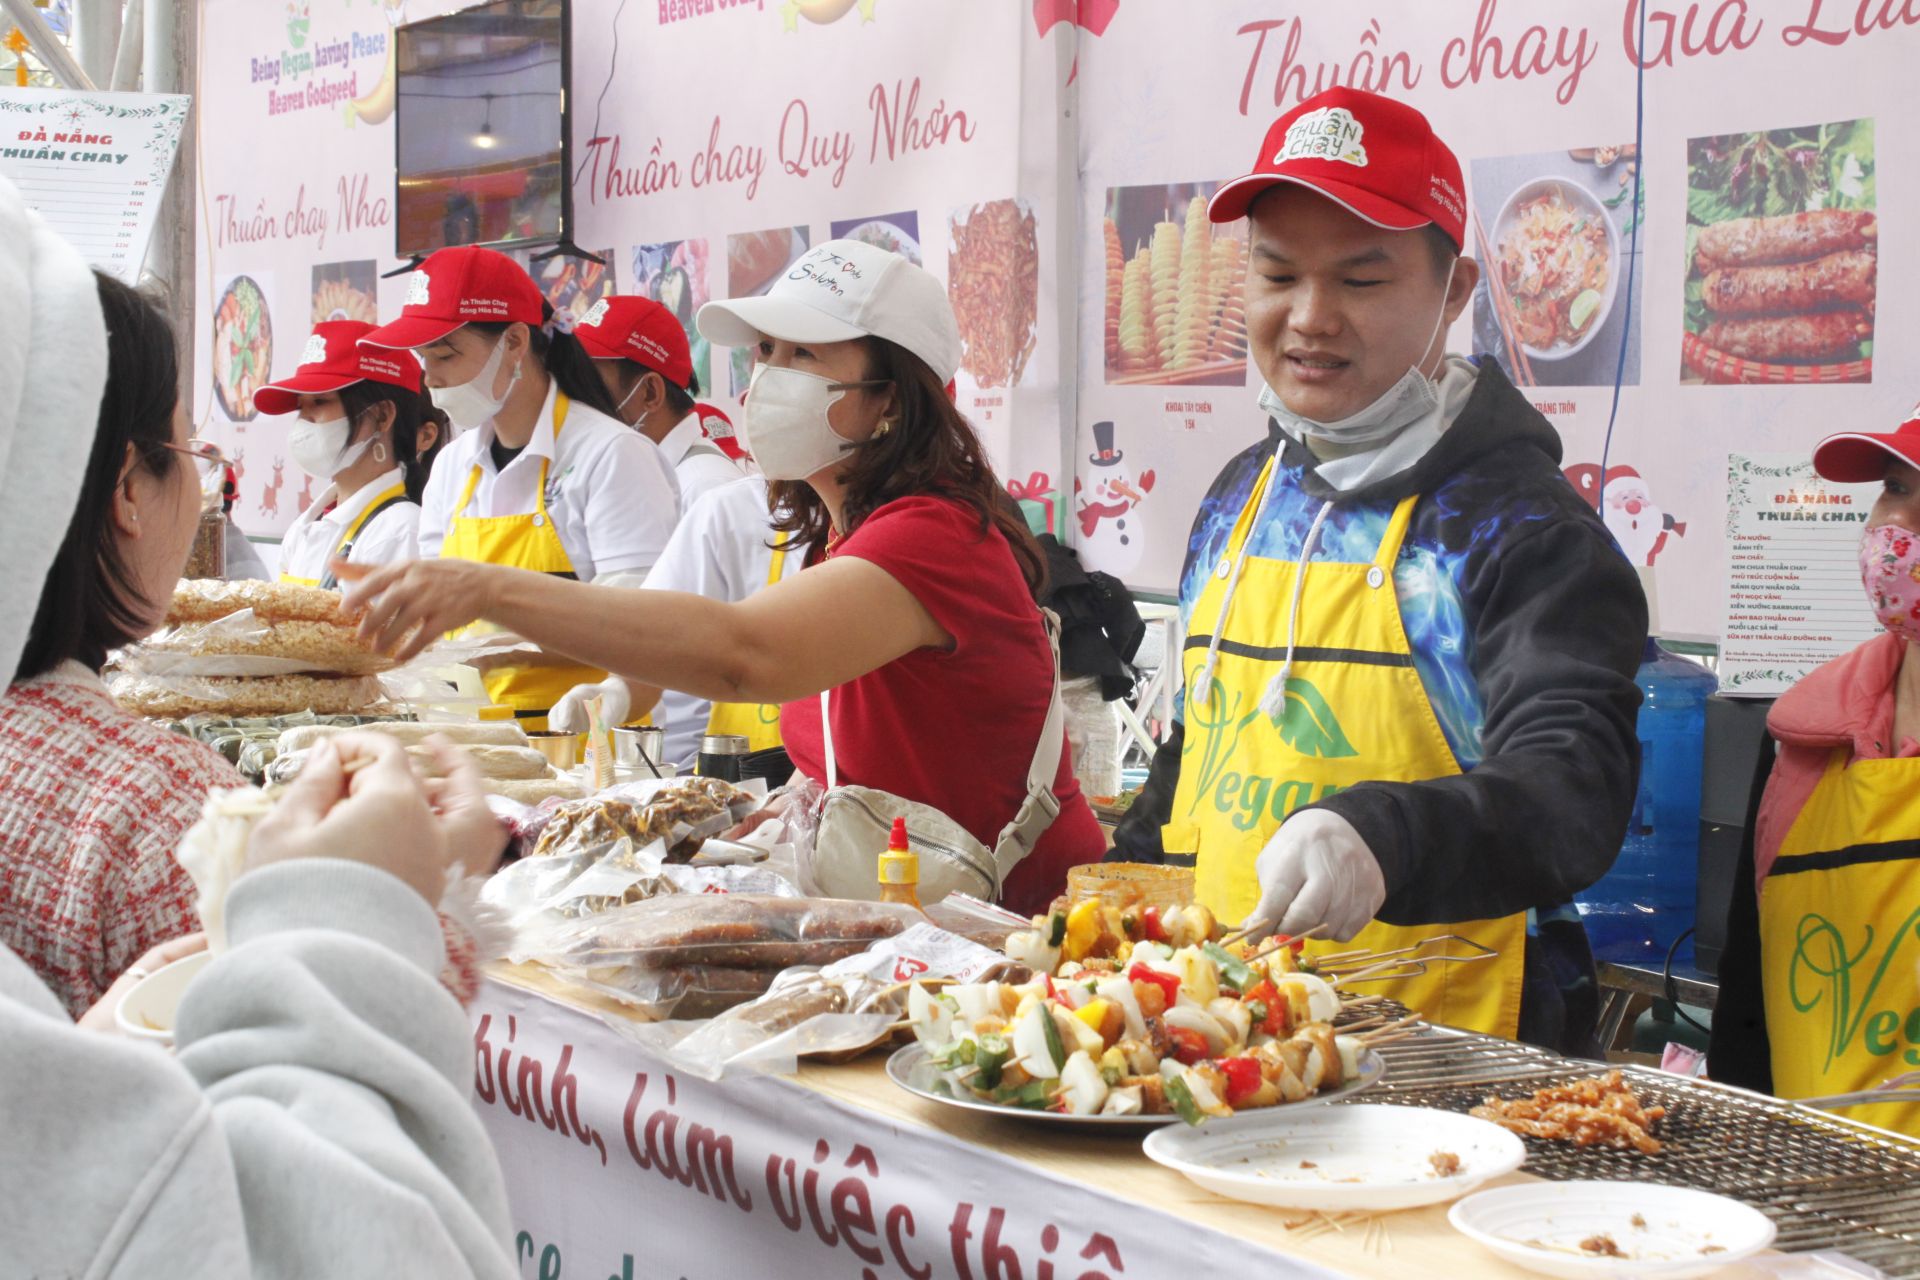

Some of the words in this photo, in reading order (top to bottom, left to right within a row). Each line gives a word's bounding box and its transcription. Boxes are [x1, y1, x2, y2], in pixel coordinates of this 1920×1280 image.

[251, 56, 280, 85] Being
[315, 37, 349, 68] having
[352, 32, 385, 59] Peace
[1440, 0, 1598, 105] chay
[268, 89, 304, 116] Heaven
[307, 71, 357, 110] Godspeed
[70, 152, 128, 164] CHAY
[586, 136, 681, 205] Thuần
[691, 116, 765, 200] chay
[778, 99, 854, 189] Quy
[869, 77, 976, 165] Nhơn
[216, 194, 277, 249] Thuần
[285, 183, 328, 251] chay
[337, 173, 391, 234] Nha
[789, 263, 844, 296] Solution
[1165, 402, 1184, 413] KHOAI
[1821, 511, 1868, 523] CHAY
[1789, 905, 1920, 1075] Ve
[623, 1072, 752, 1213] làm
[765, 1138, 933, 1280] việc
